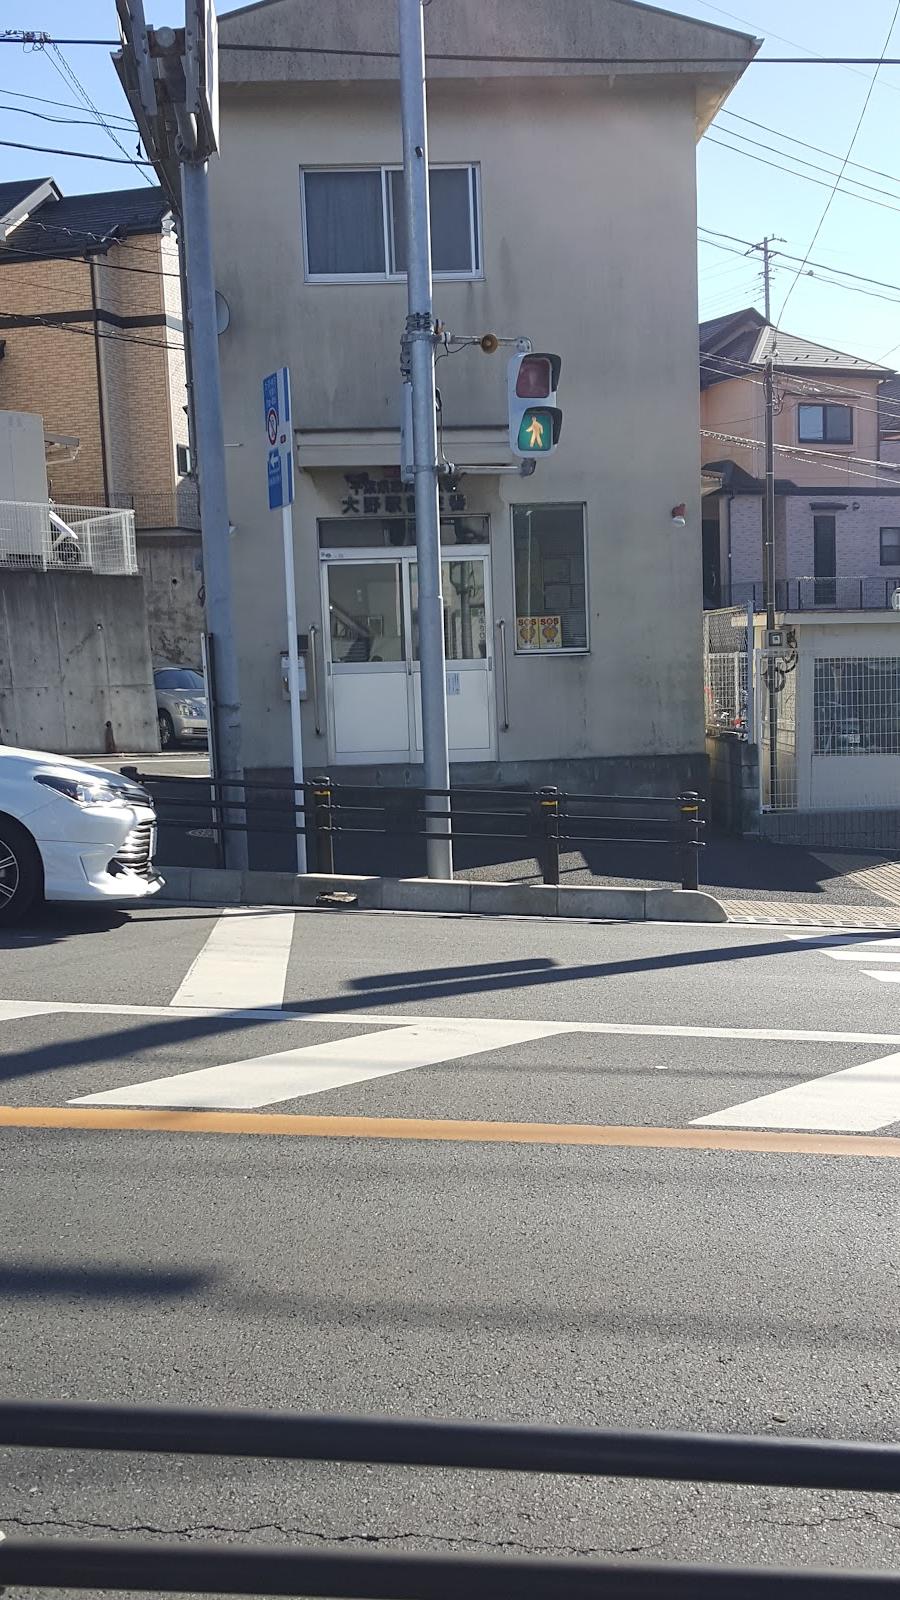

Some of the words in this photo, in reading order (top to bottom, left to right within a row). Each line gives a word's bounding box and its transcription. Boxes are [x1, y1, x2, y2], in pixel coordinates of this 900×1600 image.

[342, 495, 466, 514] 大野駅前番
[518, 618, 537, 626] SOS
[540, 617, 559, 625] SOS
